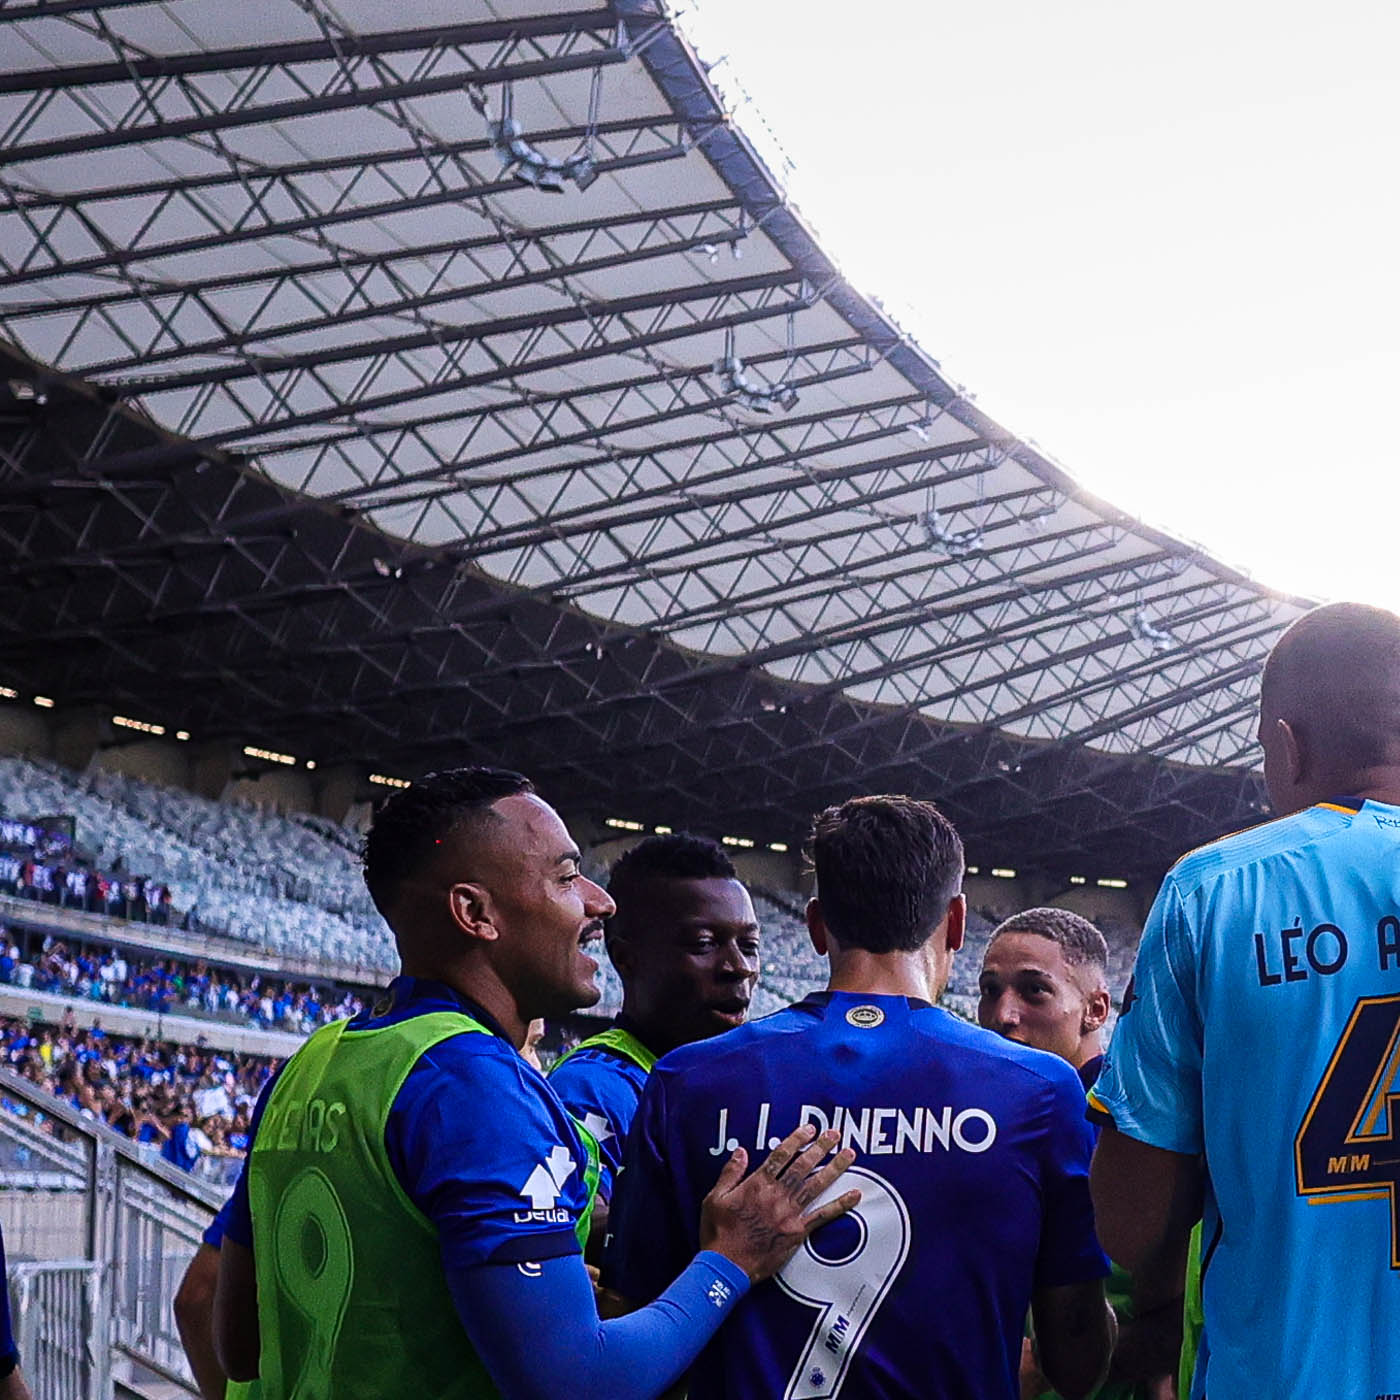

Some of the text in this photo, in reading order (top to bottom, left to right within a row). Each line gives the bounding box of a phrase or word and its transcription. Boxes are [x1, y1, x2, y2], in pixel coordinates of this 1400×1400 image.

[1255, 916, 1348, 986] LÉO
[709, 1103, 997, 1156] J. I. DINENNO
